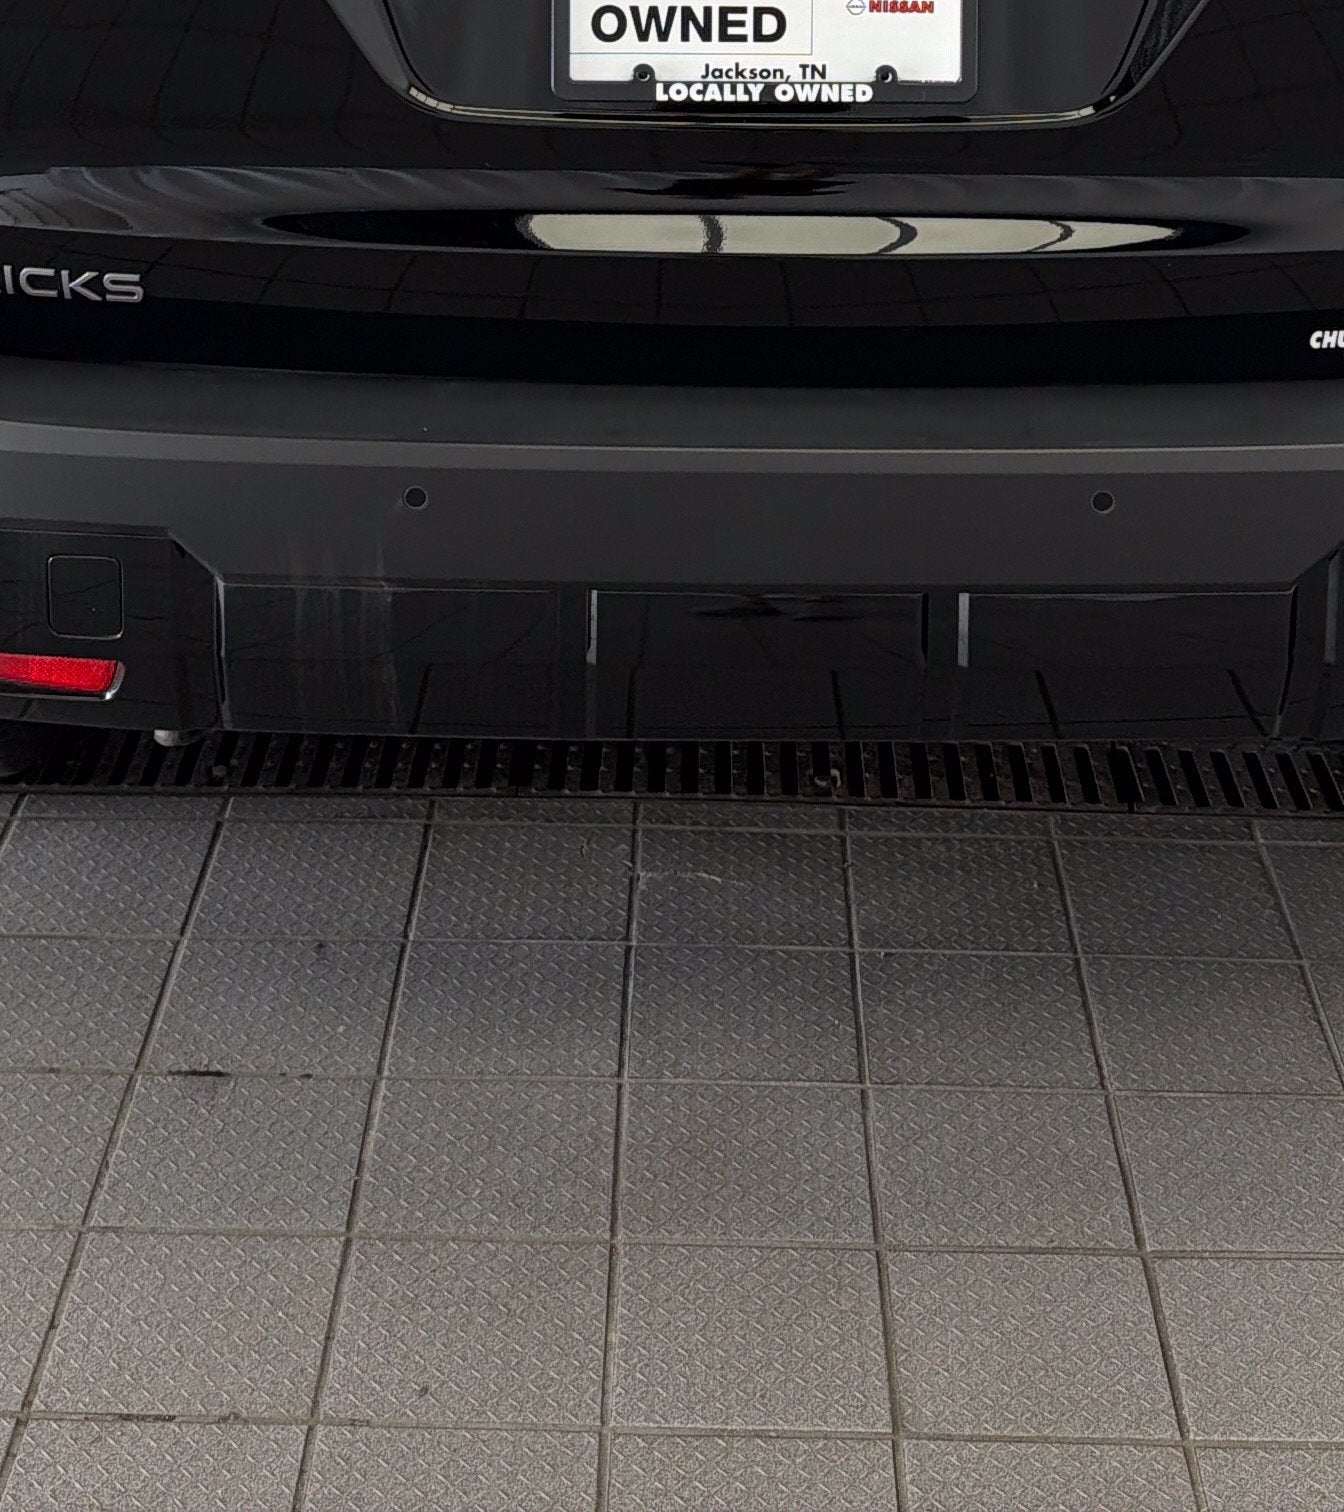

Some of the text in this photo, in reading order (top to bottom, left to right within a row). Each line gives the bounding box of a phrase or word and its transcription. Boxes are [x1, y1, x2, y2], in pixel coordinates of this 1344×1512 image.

[869, 0, 935, 13] NISSAN
[591, 5, 787, 43] OWNED
[700, 62, 827, 81] Jackson, TN
[656, 83, 873, 102] LOCALLY OWNED
